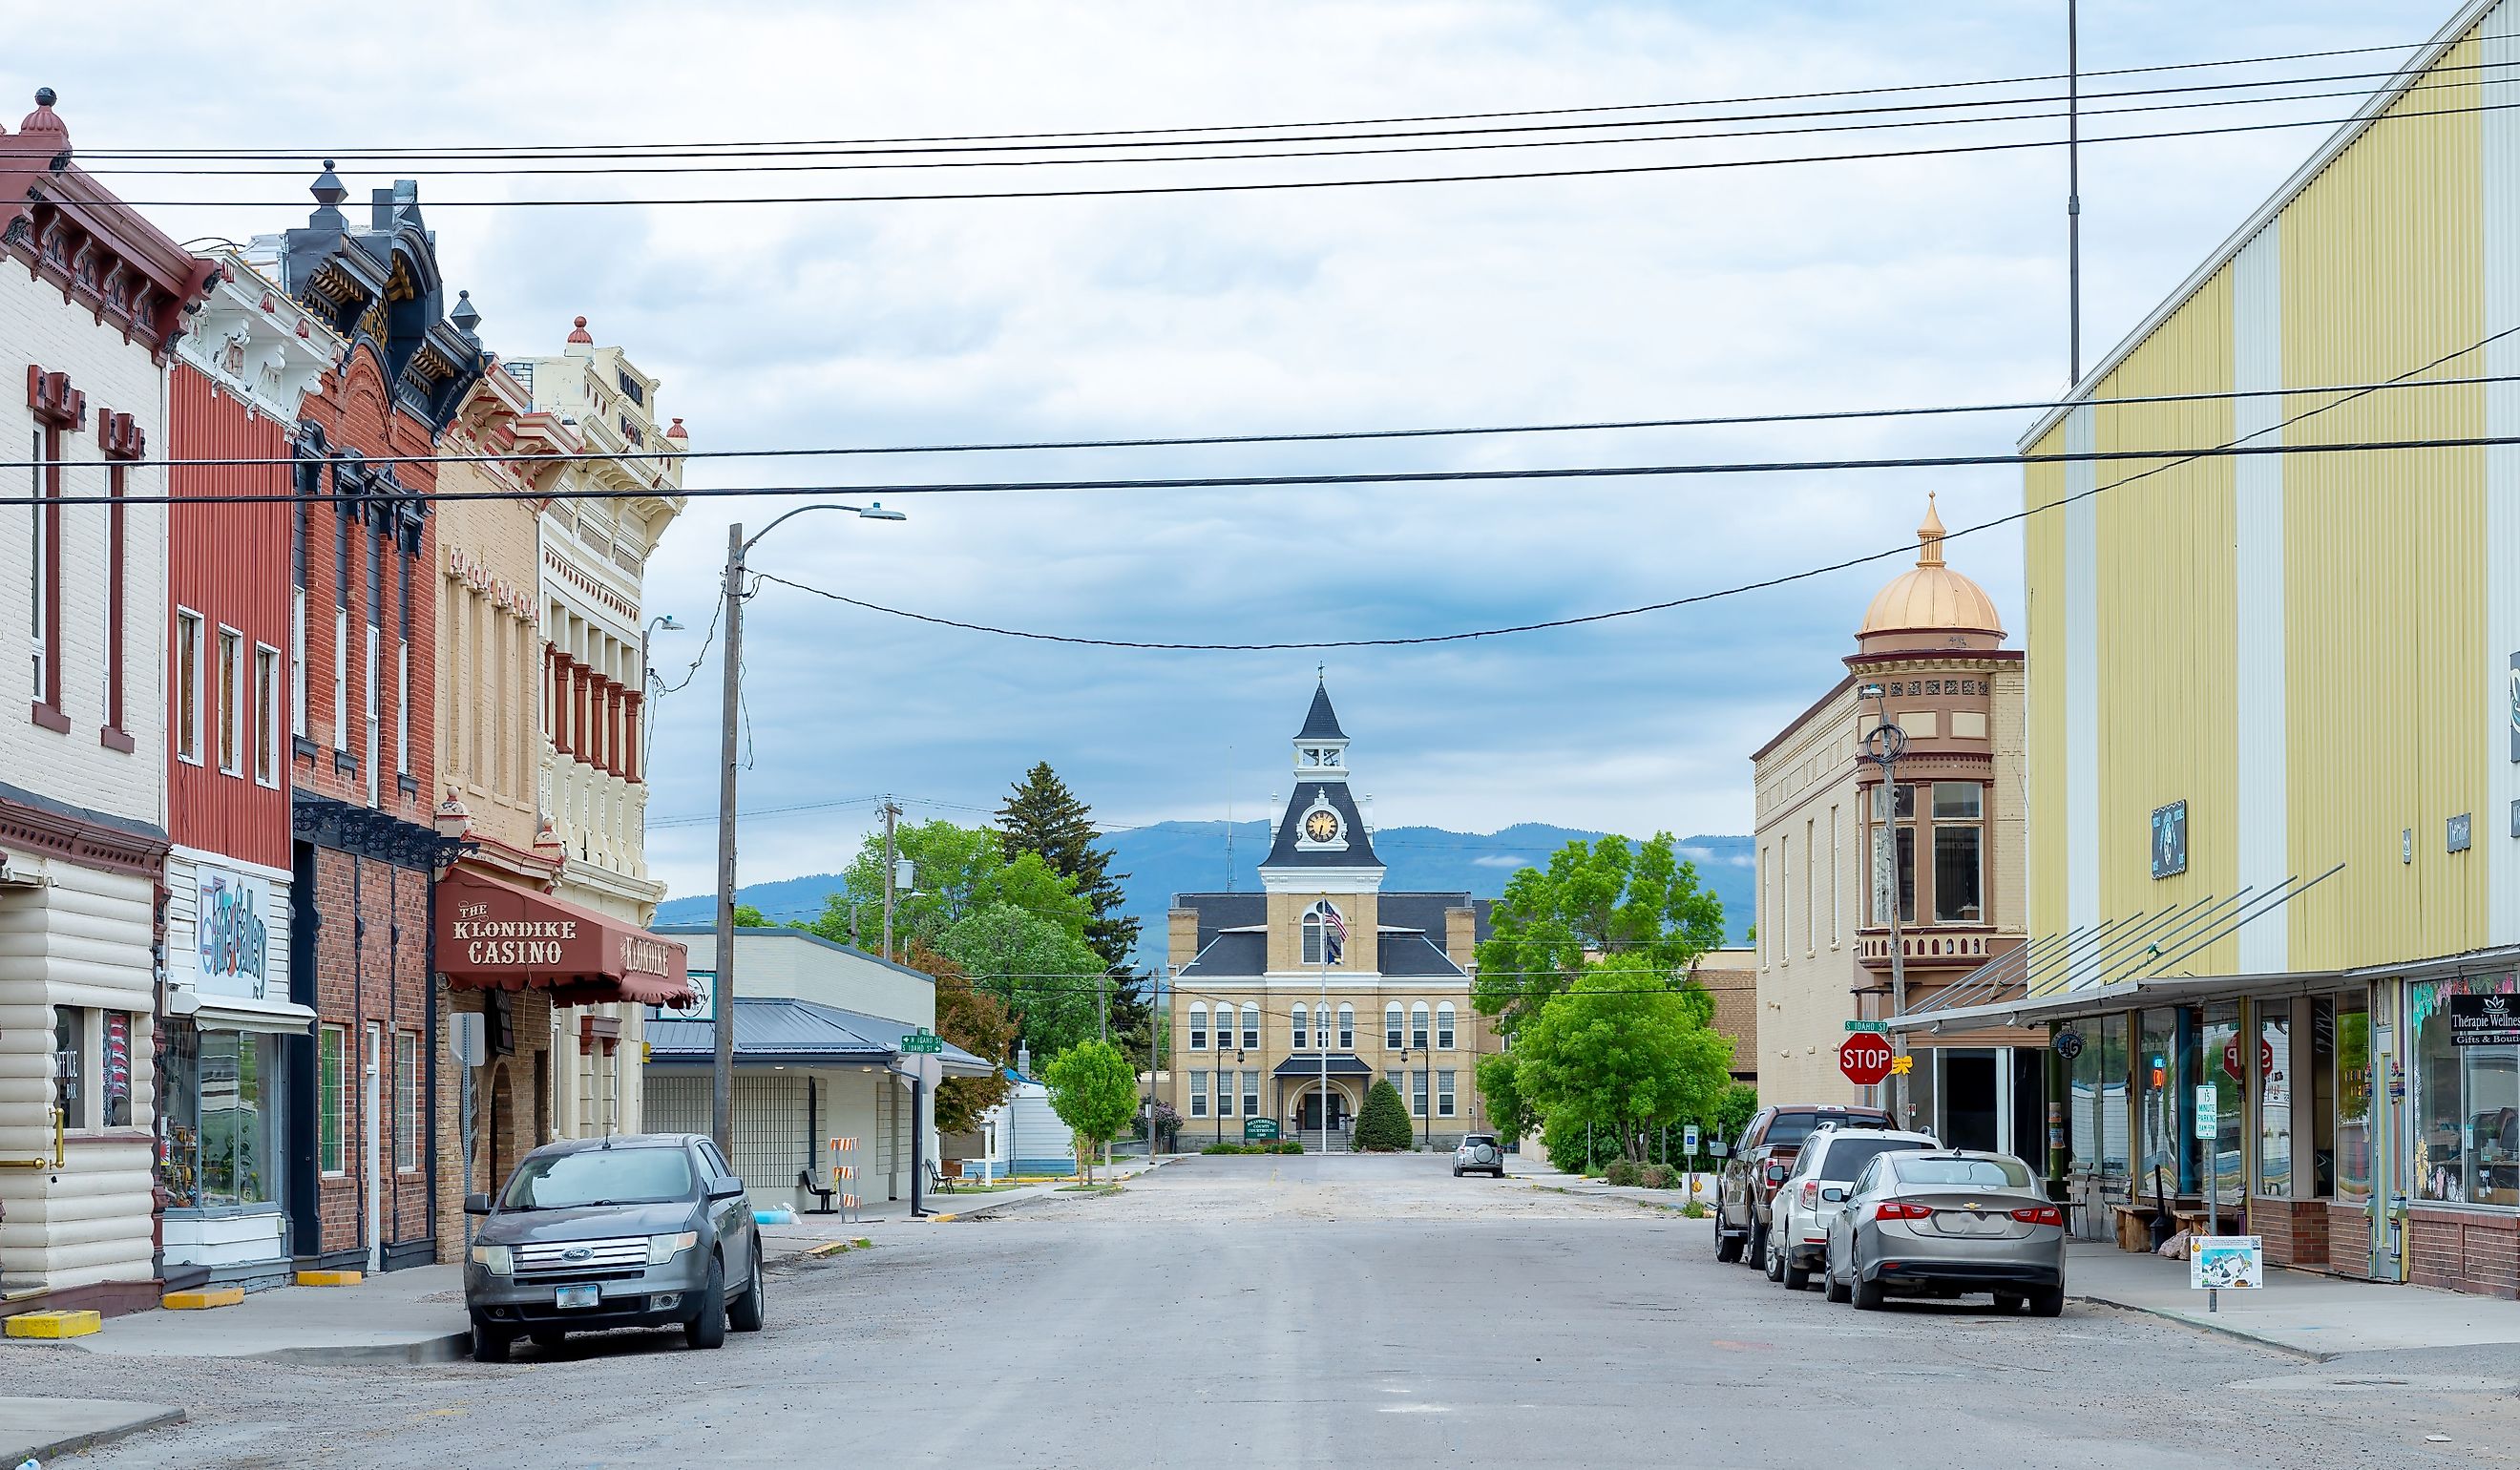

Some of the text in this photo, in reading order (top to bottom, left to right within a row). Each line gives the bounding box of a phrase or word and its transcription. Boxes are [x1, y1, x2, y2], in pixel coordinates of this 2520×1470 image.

[459, 904, 488, 918] THE
[452, 921, 577, 939] KLONDIKE
[235, 879, 266, 999] Gallery
[468, 941, 562, 965] CASINO
[625, 935, 669, 978] KLONDIKE
[1846, 1021, 1886, 1031] S IDAHO ST
[2452, 1014, 2488, 1030] Thérapie
[2493, 1035, 2520, 1043] Bouti
[1842, 1048, 1890, 1069] STOP
[66, 1083, 77, 1100] BAR
[2204, 1092, 2211, 1102] 15
[2198, 1103, 2216, 1113] MINUTE
[2198, 1114, 2216, 1123] PARKING
